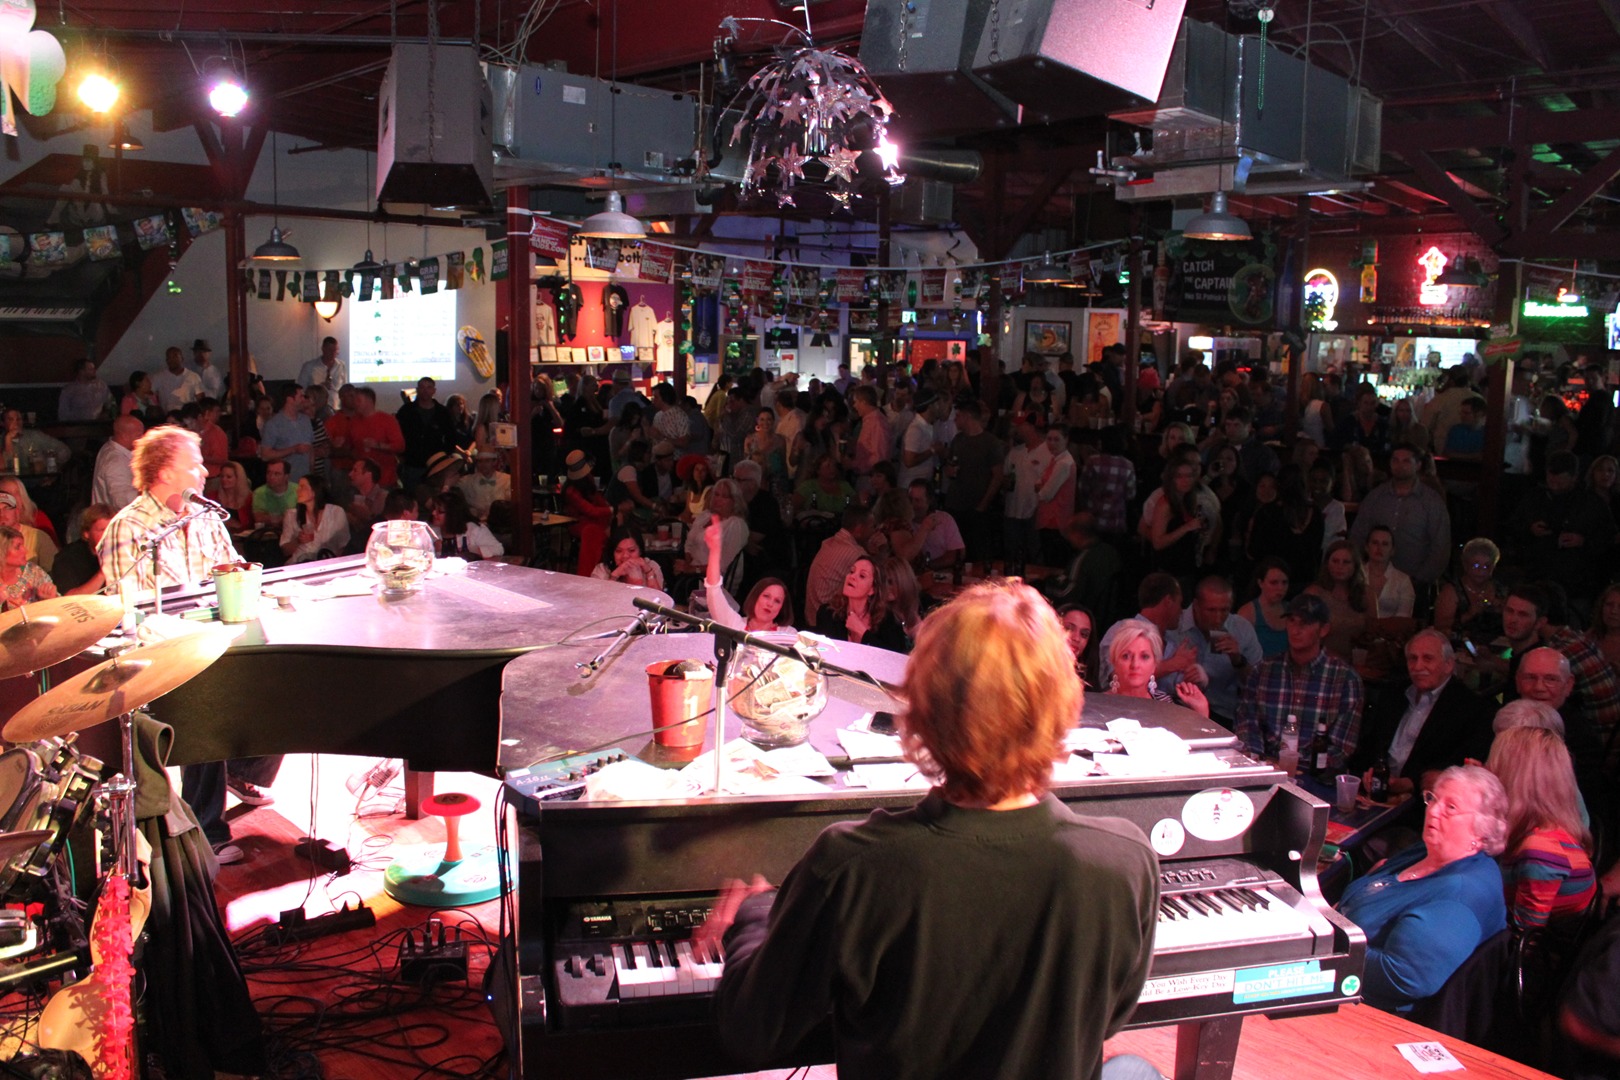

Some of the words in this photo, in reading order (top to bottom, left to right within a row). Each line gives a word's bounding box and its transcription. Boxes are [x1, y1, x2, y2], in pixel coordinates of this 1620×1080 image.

[1183, 259, 1215, 273] CATCH
[1194, 276, 1236, 290] CAPTAIN
[60, 602, 95, 623] SABIAN
[48, 700, 106, 715] SABIAN
[1268, 966, 1305, 978] PLEASE
[1169, 978, 1188, 986] Wish
[1190, 977, 1209, 985] Every
[1244, 979, 1282, 991] DON'T
[1287, 976, 1305, 986] HIT
[1310, 975, 1325, 984] ME
